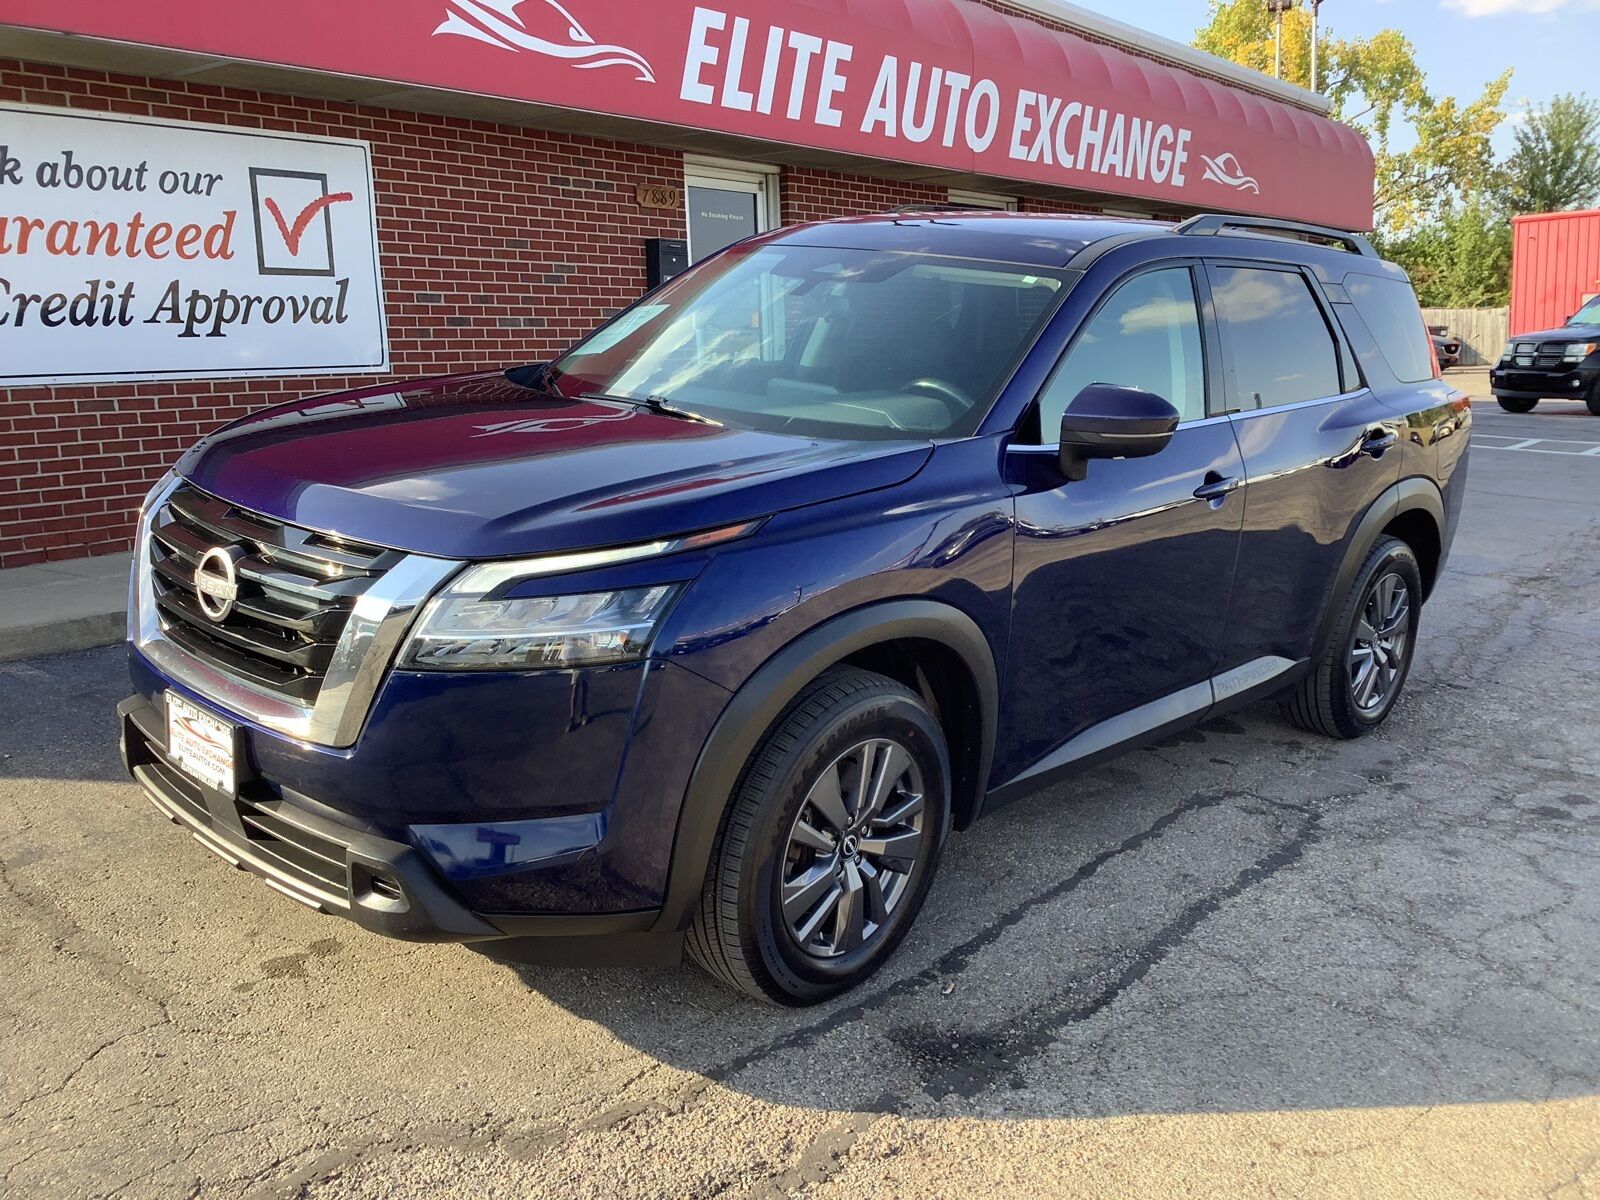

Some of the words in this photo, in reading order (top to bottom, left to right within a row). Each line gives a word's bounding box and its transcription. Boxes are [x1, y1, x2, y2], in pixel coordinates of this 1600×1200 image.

[680, 6, 853, 127] ELITE
[859, 54, 1000, 153] AUTO
[1009, 88, 1192, 187] EXCHANGE
[36, 150, 148, 193] about
[159, 169, 223, 197] our
[643, 188, 676, 206] 7889
[143, 277, 350, 338] Approval
